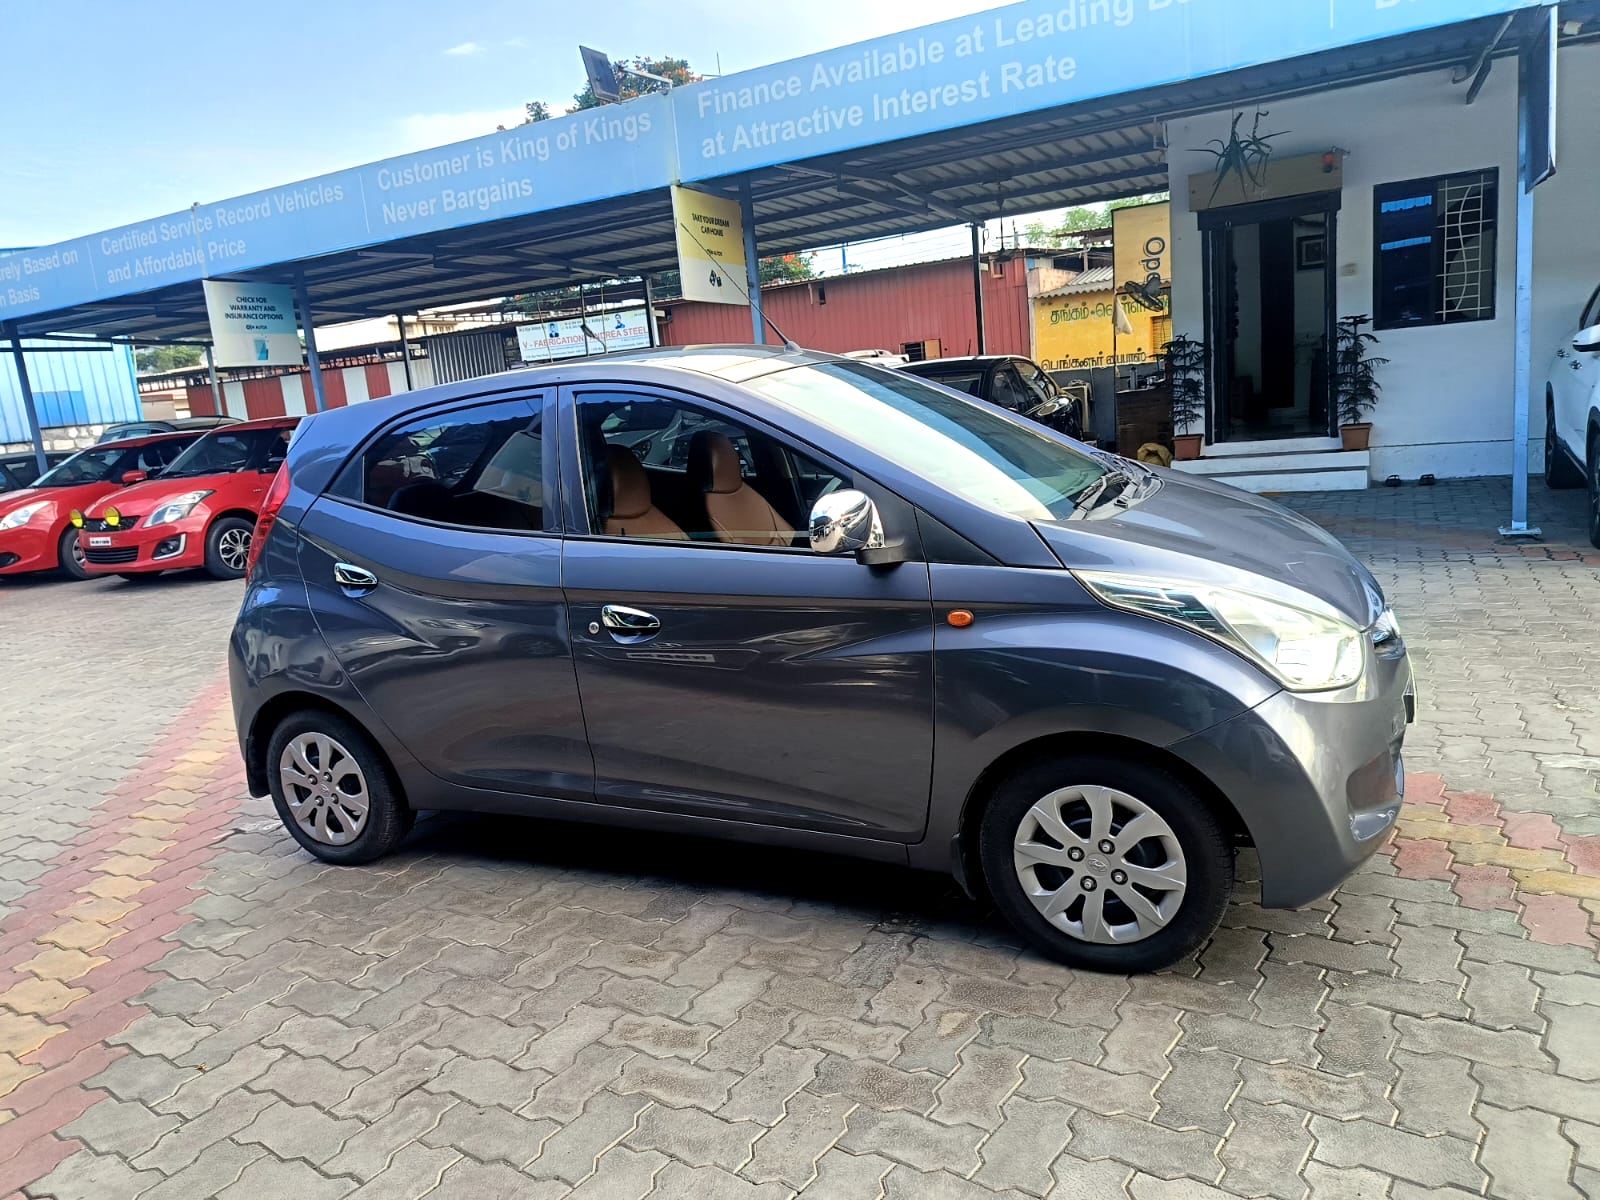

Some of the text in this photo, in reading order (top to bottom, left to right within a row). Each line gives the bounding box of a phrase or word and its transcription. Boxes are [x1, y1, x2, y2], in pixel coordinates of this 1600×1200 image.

[697, 0, 1135, 119] Finance Available at Leading
[701, 53, 1077, 159] at Attractive Interest Rate
[378, 112, 651, 191] Customer is King of Kings
[101, 183, 344, 256] Certified Service Record Vehicles
[382, 177, 533, 225] Never Bargains
[23, 250, 61, 275] Based
[62, 249, 79, 265] on
[107, 238, 247, 284] and Affordable Price
[7, 284, 40, 305] Basis
